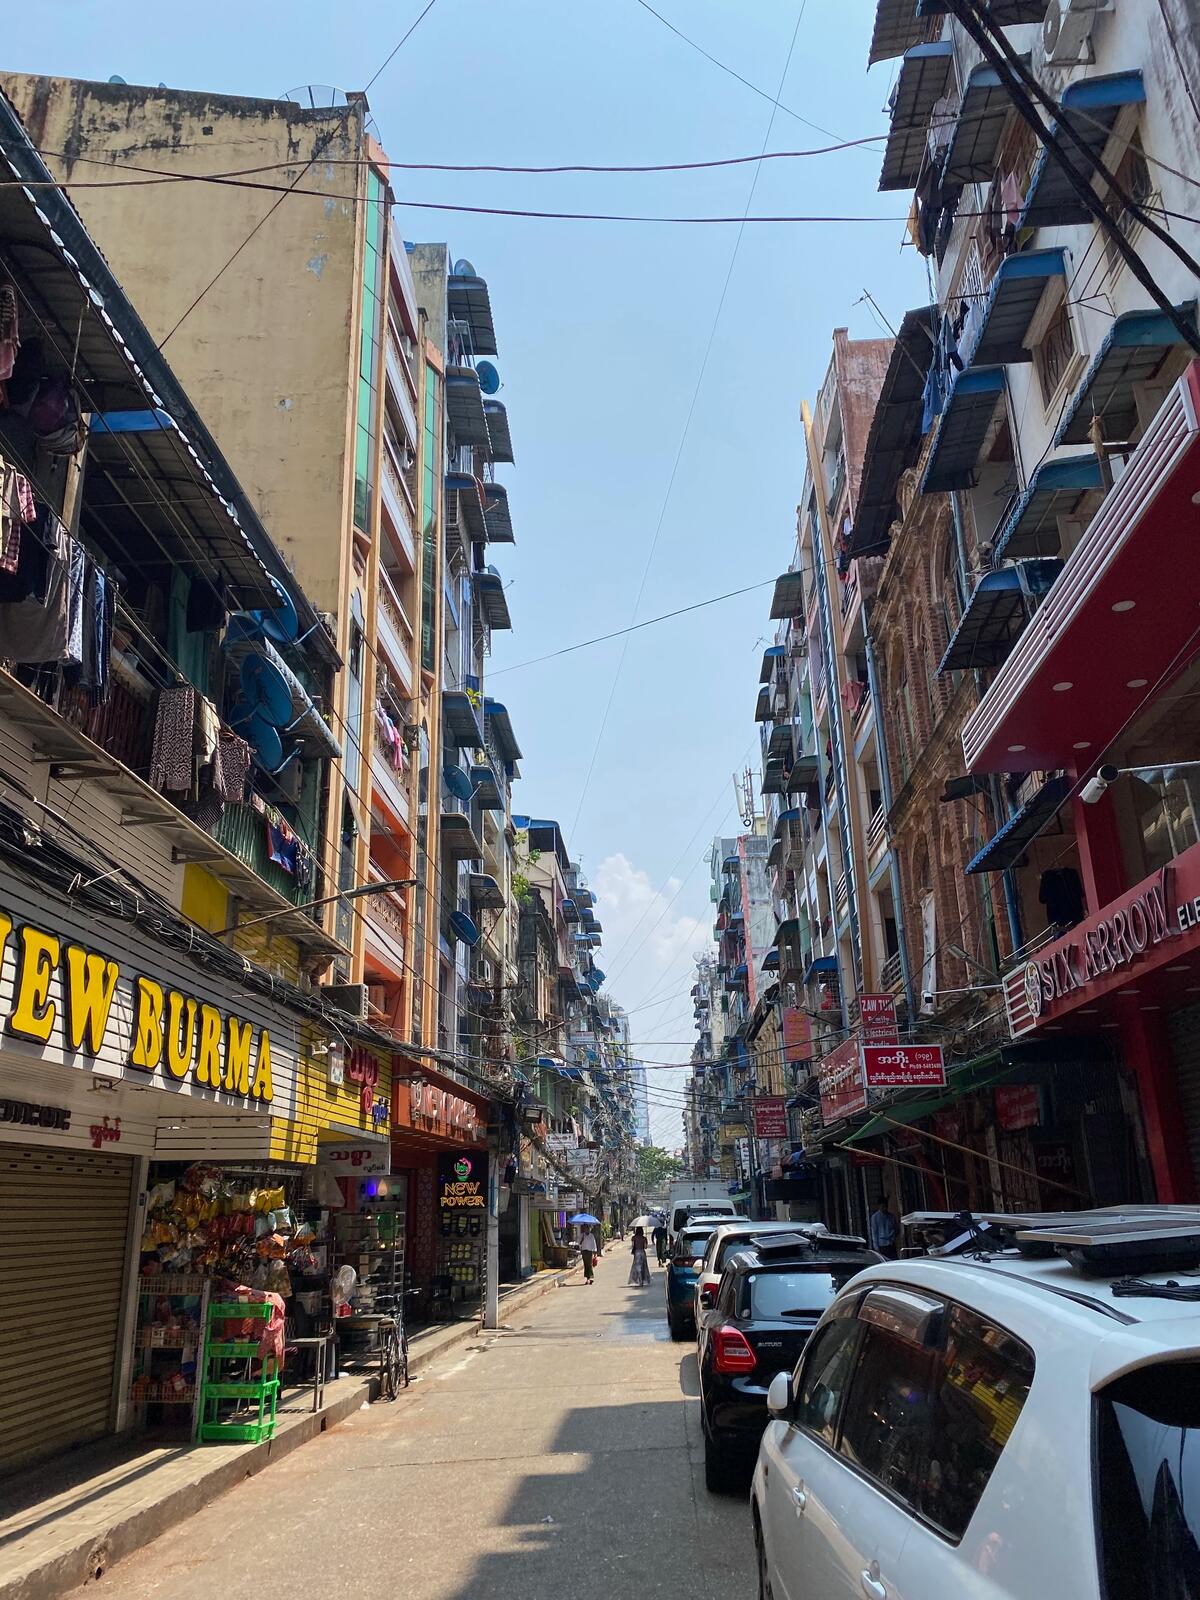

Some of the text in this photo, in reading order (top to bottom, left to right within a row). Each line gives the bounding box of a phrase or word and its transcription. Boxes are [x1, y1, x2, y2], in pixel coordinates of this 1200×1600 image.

[1041, 944, 1083, 1001] SIX
[1083, 867, 1174, 982] ARROW
[131, 975, 273, 1102] BURMA
[861, 999, 893, 1012] ZAW TUN
[440, 1195, 485, 1207] POWER
